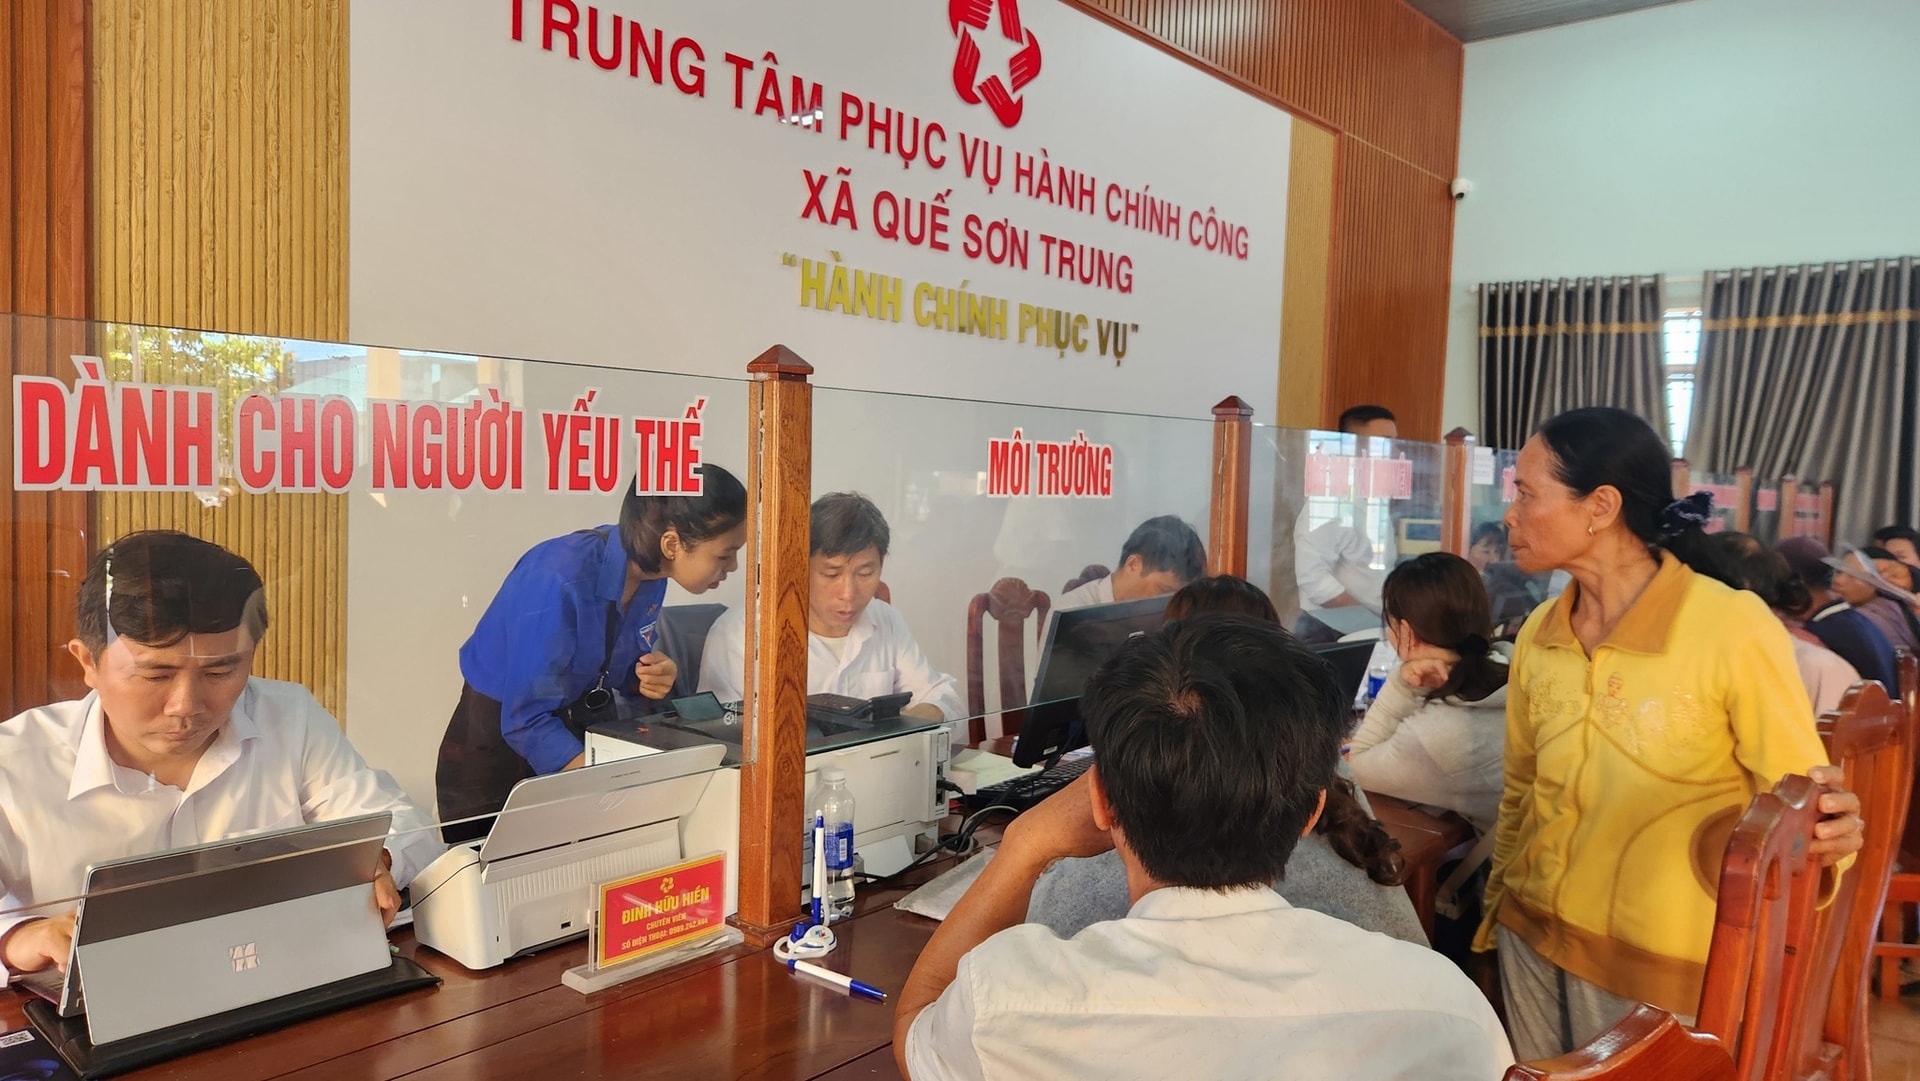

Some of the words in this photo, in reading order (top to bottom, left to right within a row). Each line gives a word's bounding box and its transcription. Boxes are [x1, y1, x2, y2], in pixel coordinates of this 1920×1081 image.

[724, 51, 823, 133] TÂM
[841, 91, 946, 169] PHỤC
[959, 132, 1002, 194] VỤ
[1014, 147, 1096, 215] HÀNH
[1105, 185, 1181, 241] CHÍNH
[1188, 207, 1249, 260] CÔNG
[800, 166, 859, 231] XÃ
[872, 188, 951, 253] QUẾ
[962, 214, 1029, 271] SƠN
[1039, 234, 1134, 295] TRUNG
[913, 279, 1009, 341] CHÍNH
[1017, 302, 1090, 359] PHỤC
[20, 361, 213, 487] DÀNH
[239, 396, 355, 490] CHO
[372, 389, 524, 492] NGƯỜI
[542, 390, 620, 493] YẾU
[634, 398, 705, 493] THẾ
[988, 429, 1031, 496] MÔI
[1036, 432, 1113, 496] TRƯỜNG
